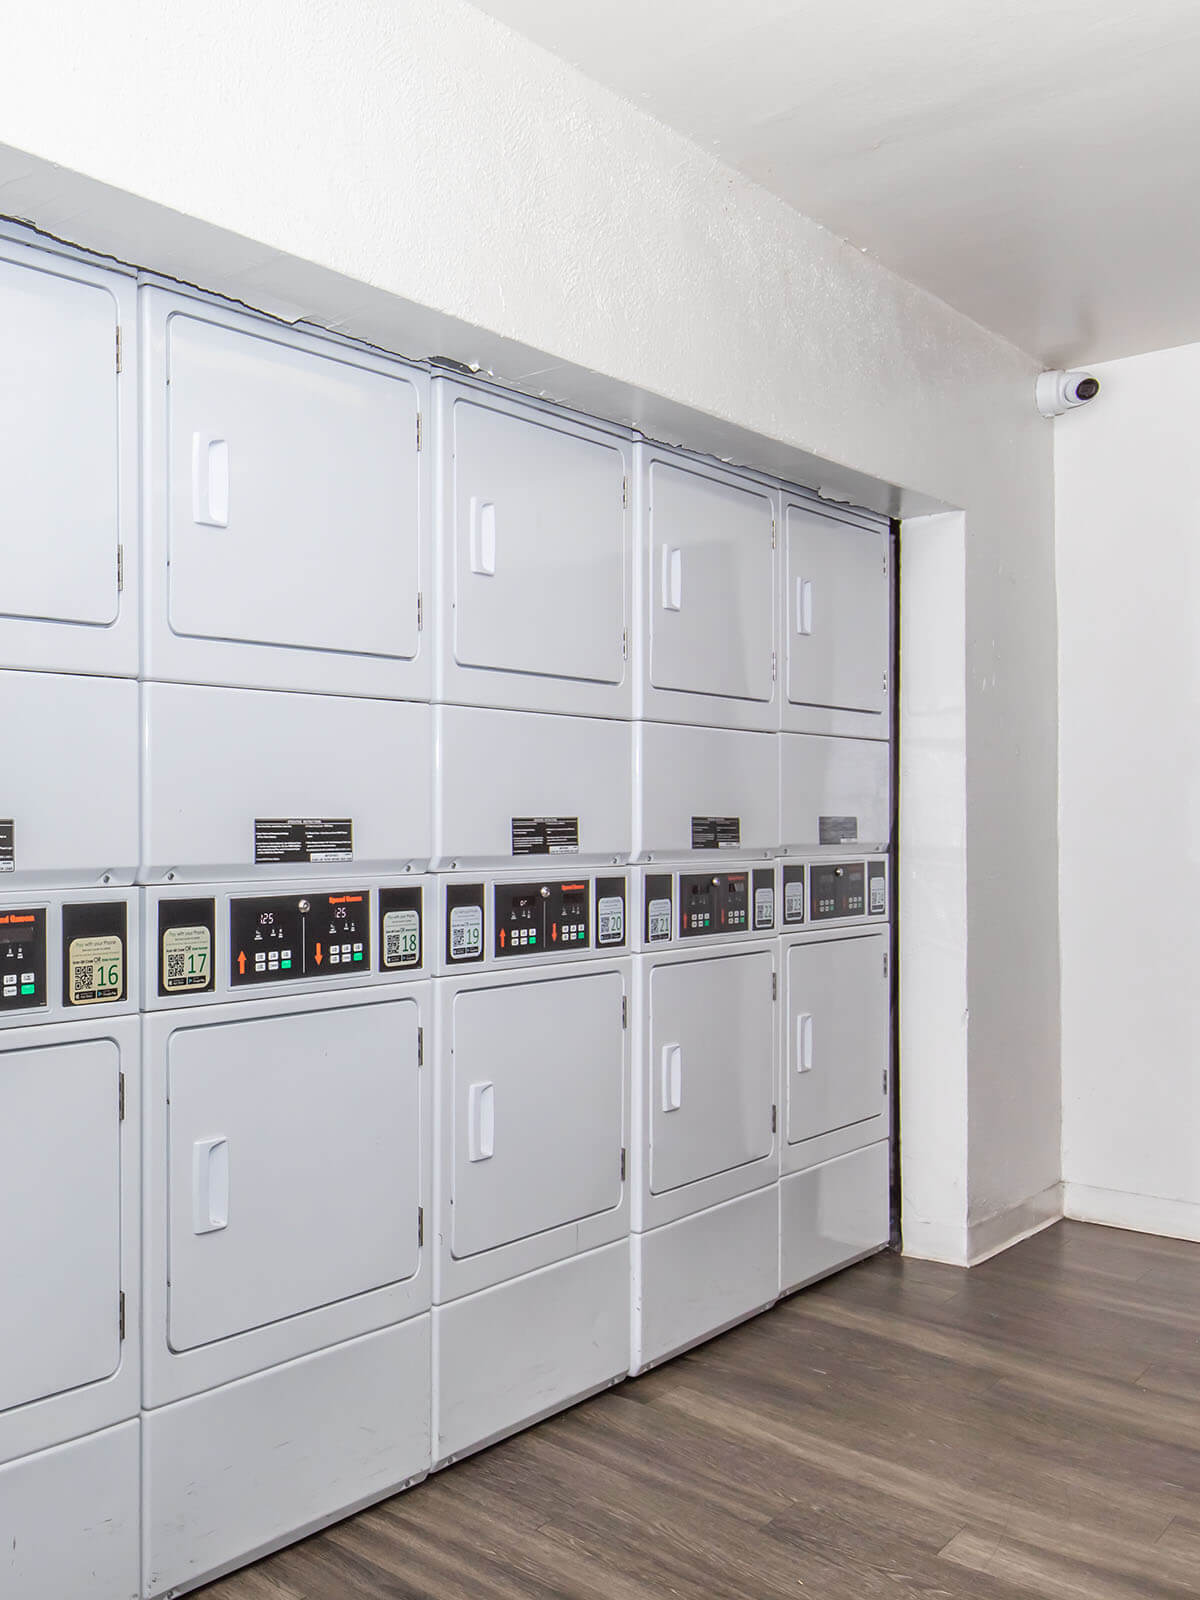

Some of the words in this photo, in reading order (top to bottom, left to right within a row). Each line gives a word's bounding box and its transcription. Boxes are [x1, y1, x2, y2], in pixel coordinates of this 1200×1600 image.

[610, 916, 621, 931] 20
[402, 934, 416, 952] 18
[466, 927, 479, 945] 19
[188, 953, 207, 974] 17
[97, 964, 118, 986] 16
